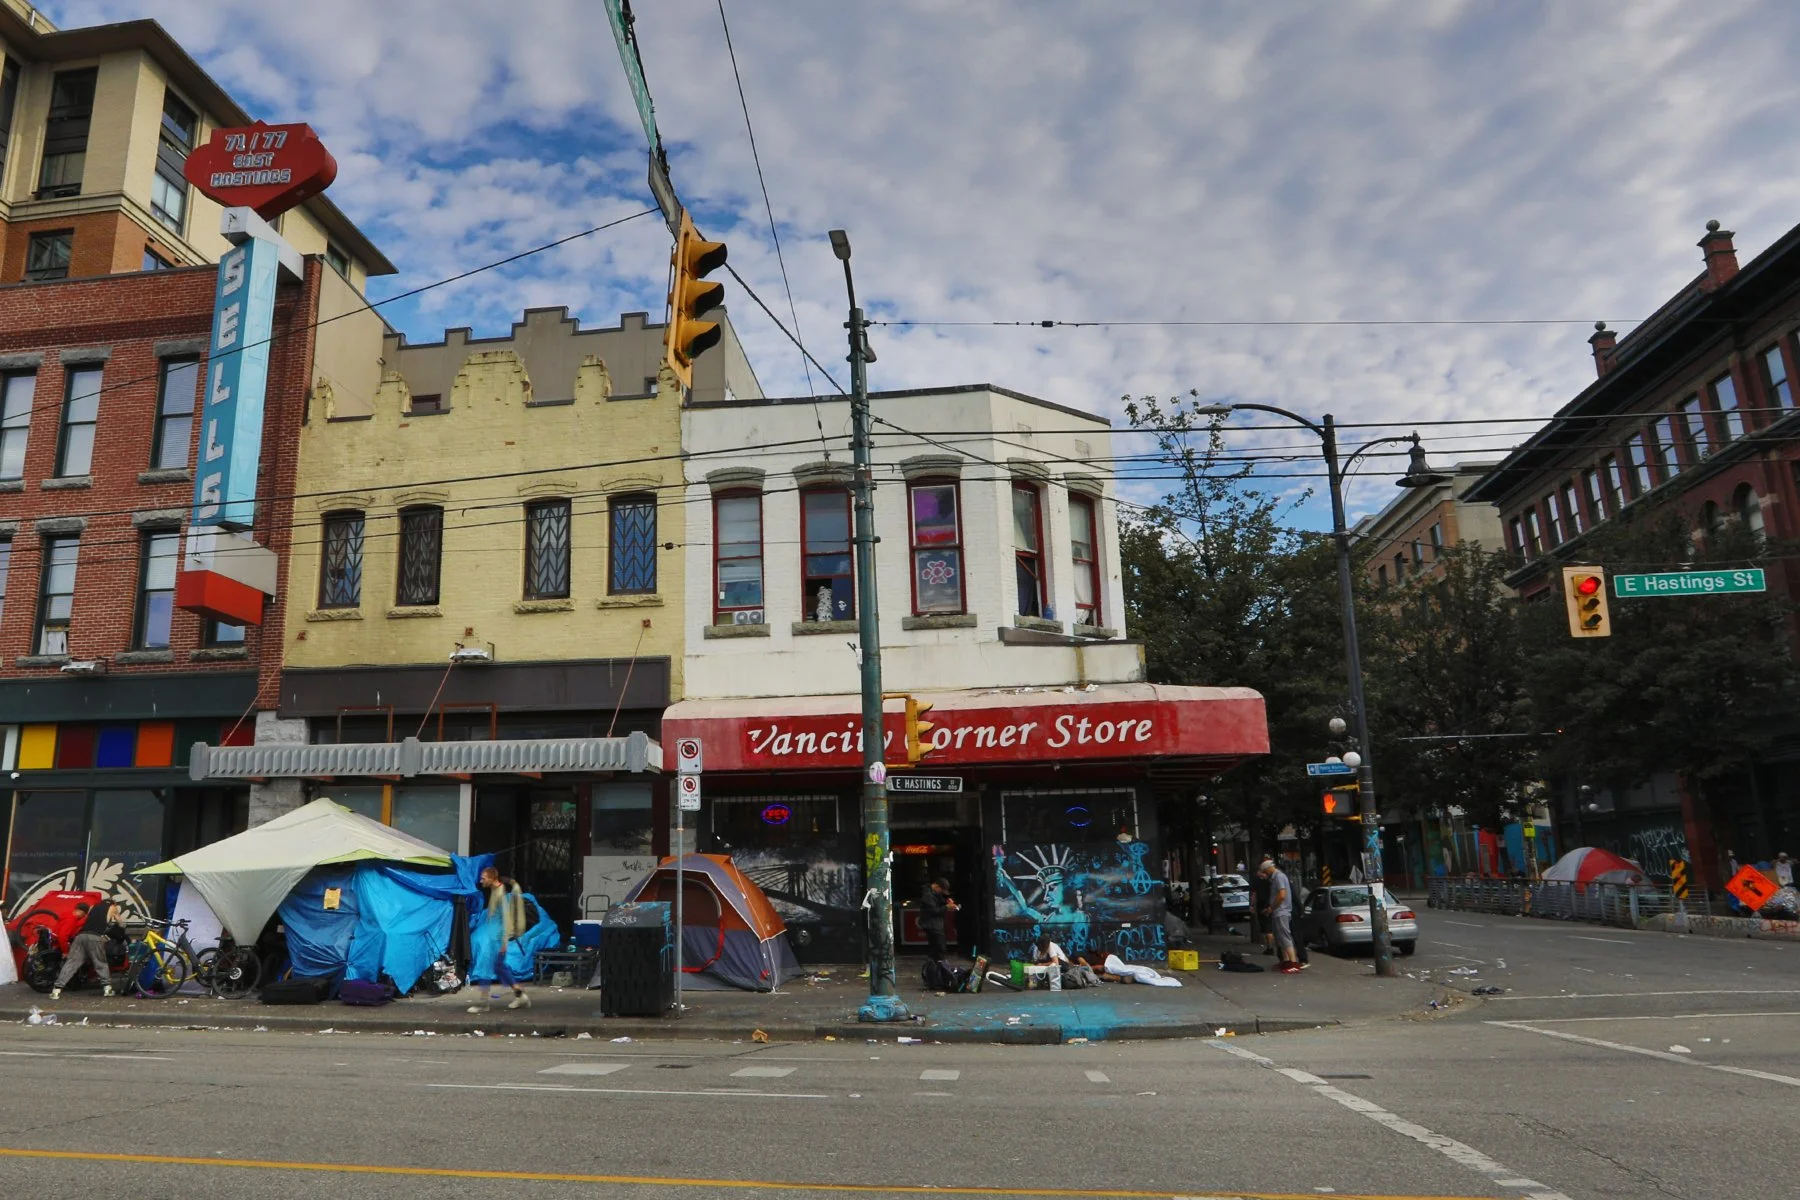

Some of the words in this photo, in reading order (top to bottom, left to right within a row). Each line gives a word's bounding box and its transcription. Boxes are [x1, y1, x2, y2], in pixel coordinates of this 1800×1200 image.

[233, 152, 275, 168] EAST
[210, 168, 292, 187] HASTINGS
[198, 247, 246, 522] SELLS
[1623, 577, 1637, 592] E
[1644, 574, 1725, 591] Hastings
[1733, 572, 1755, 587] St
[1047, 714, 1153, 748] Store
[896, 778, 901, 789] E
[904, 778, 942, 790] HASTINGS
